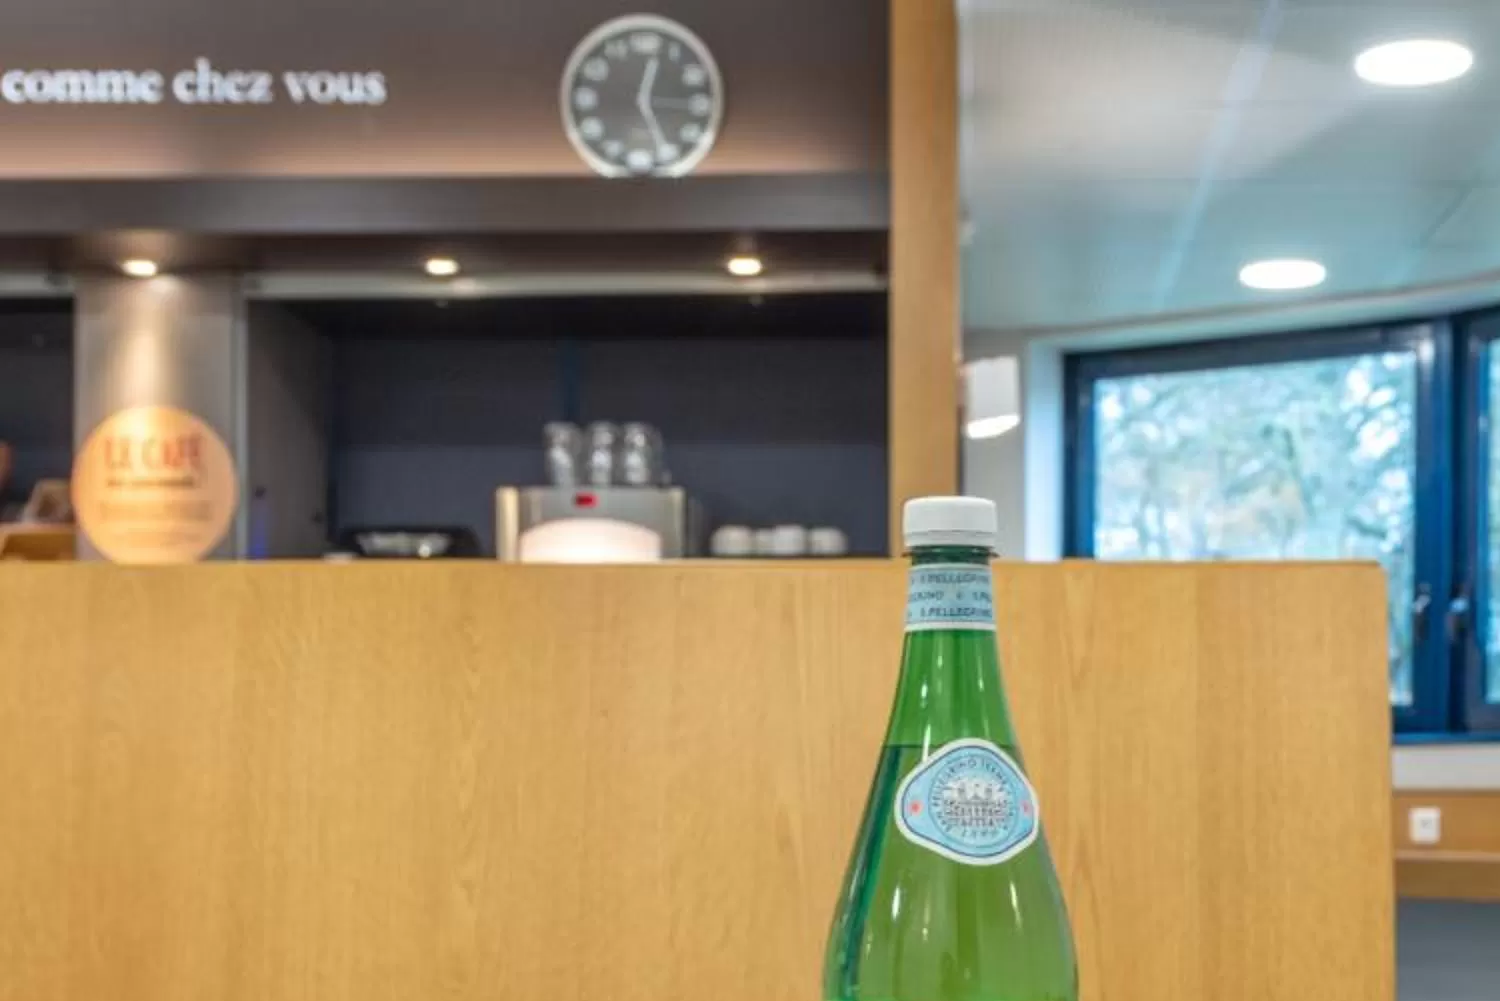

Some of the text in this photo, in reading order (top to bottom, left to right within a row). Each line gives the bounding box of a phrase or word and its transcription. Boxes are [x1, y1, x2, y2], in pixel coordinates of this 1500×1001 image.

[1, 56, 388, 105] comme chez vous
